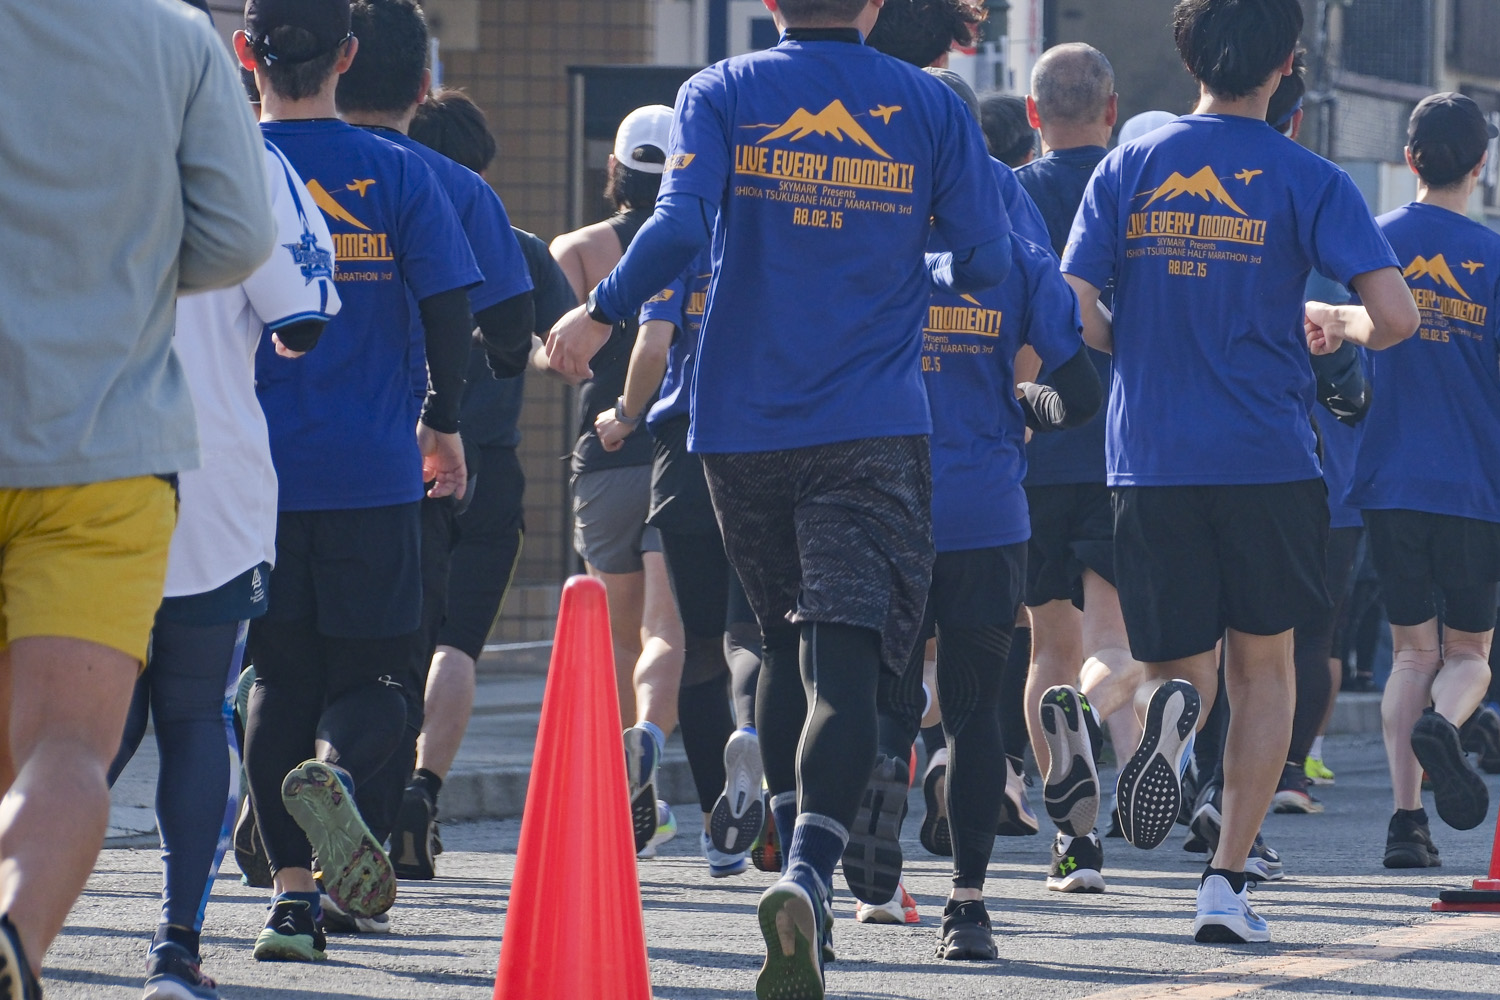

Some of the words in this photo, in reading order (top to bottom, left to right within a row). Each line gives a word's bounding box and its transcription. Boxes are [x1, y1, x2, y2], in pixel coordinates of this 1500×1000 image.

[735, 145, 769, 172] LIVE
[772, 149, 828, 180] EVERY
[832, 156, 914, 189] MOMENT!
[766, 190, 817, 205] TSUKUBANE
[819, 197, 843, 208] HALF
[845, 199, 895, 213] MARATHON
[898, 205, 912, 214] 3rd
[779, 181, 817, 194] SKYMARK
[822, 185, 856, 199] Presents
[1151, 211, 1195, 235] EVERY
[1198, 214, 1266, 242] MOMENT!
[1187, 249, 1207, 259] HALF
[1208, 251, 1248, 262] MARATHON
[1249, 256, 1262, 264] 3rd
[1189, 240, 1216, 250] Presents
[928, 305, 1002, 333] MOMENT!
